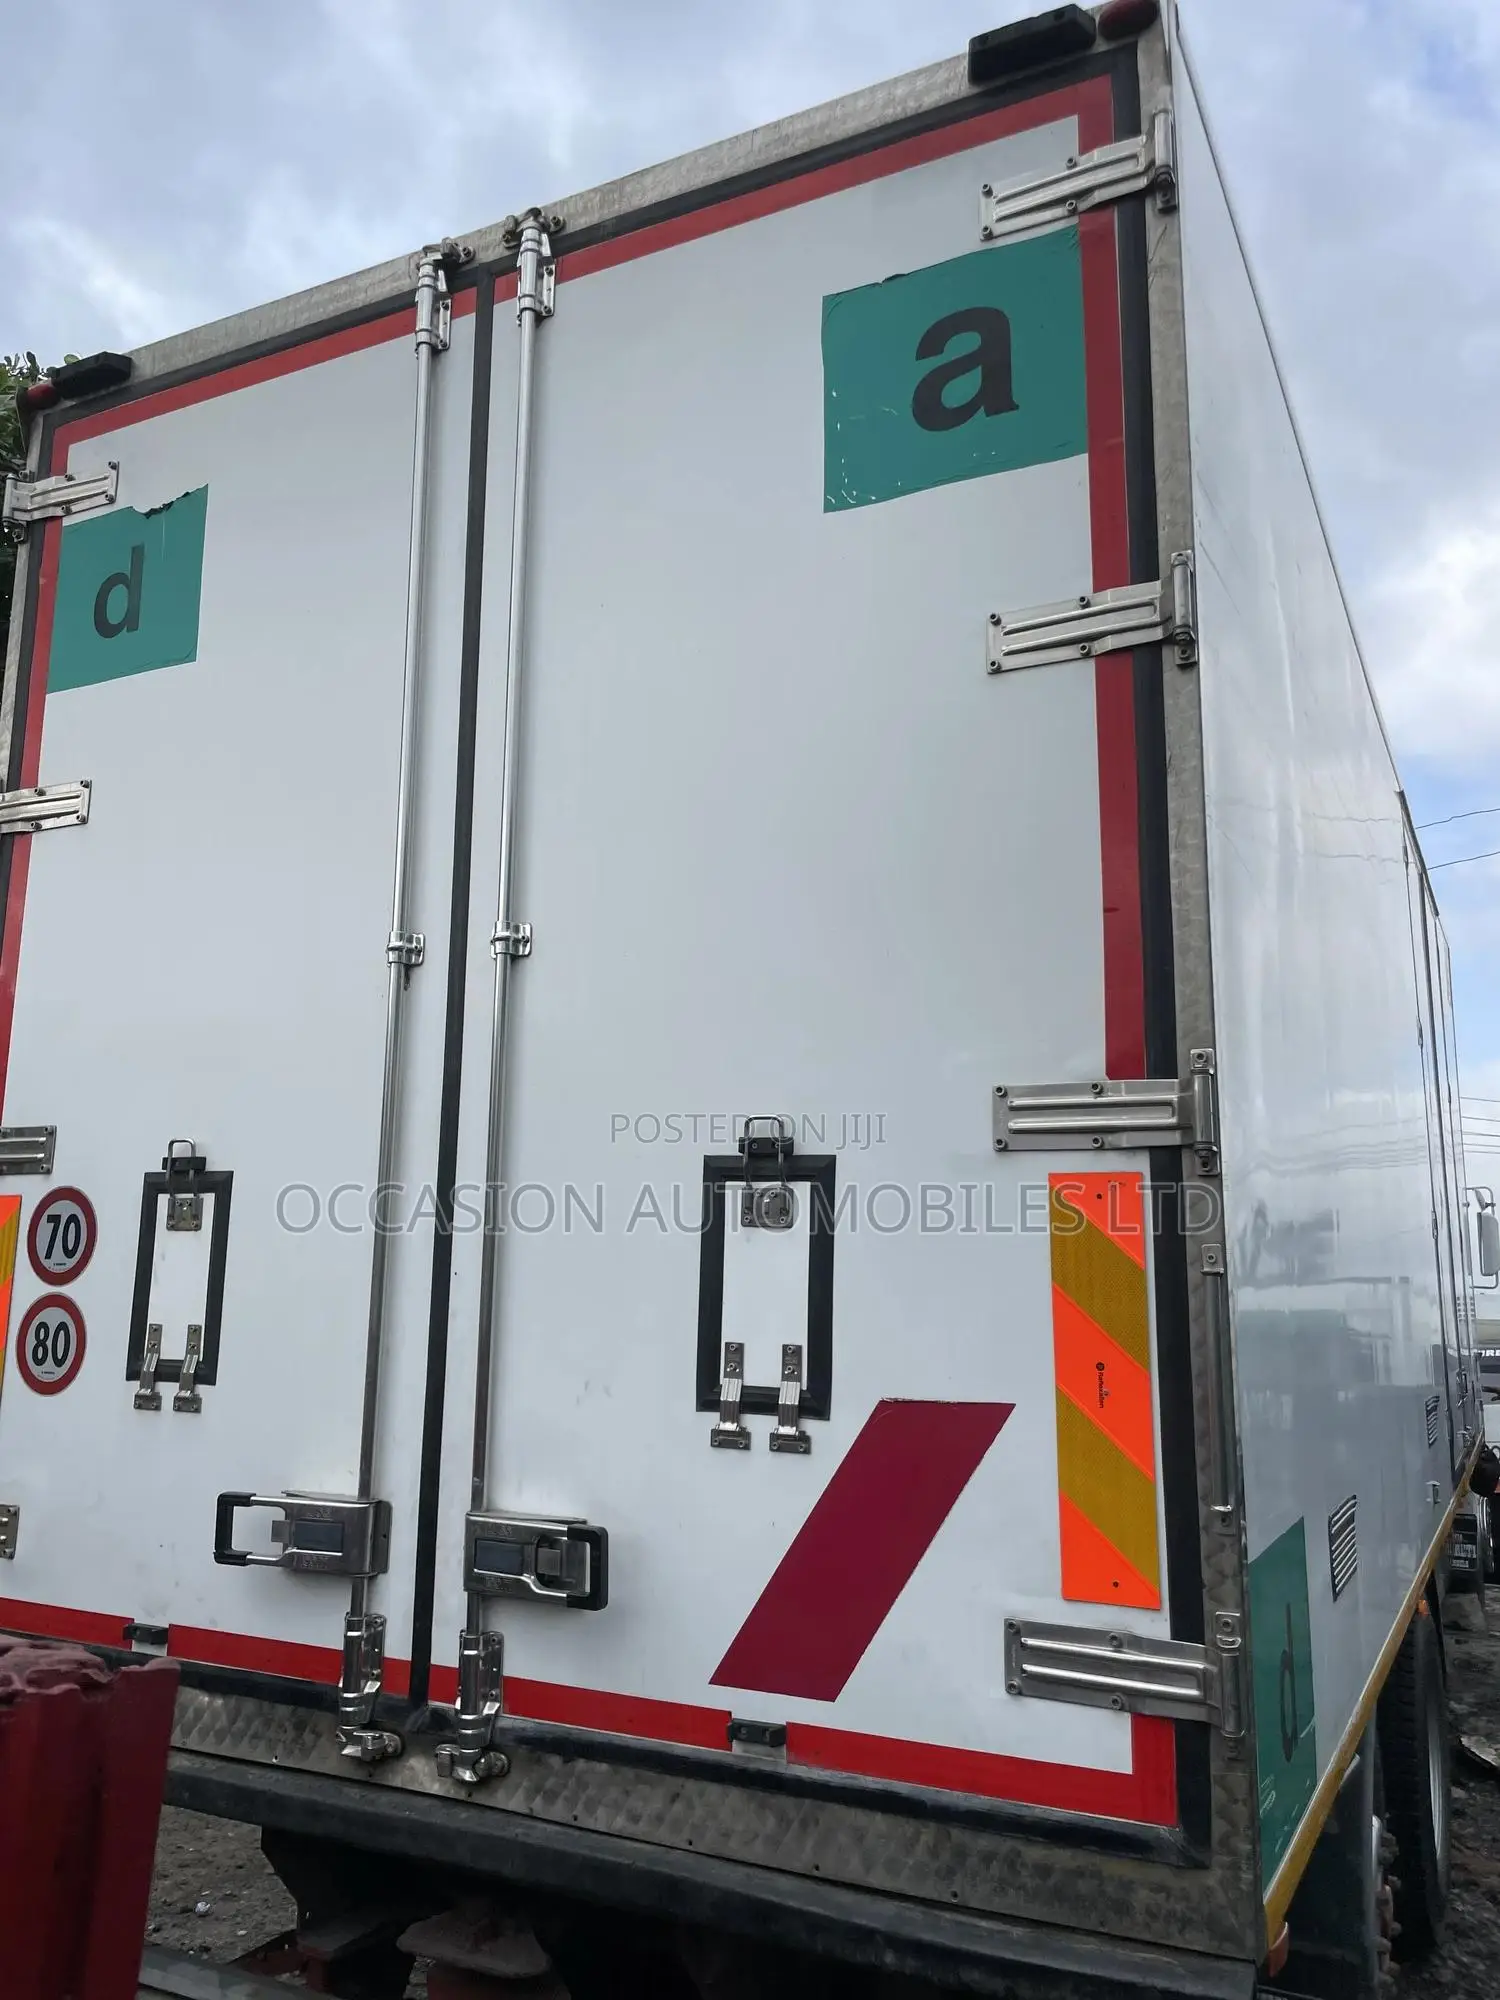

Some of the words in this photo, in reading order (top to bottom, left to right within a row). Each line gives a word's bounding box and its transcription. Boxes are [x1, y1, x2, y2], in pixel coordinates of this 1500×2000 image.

[912, 306, 1020, 432] a
[93, 543, 144, 639] d
[44, 1213, 81, 1259] 70
[32, 1321, 71, 1368] 80
[1280, 1602, 1298, 1763] d
